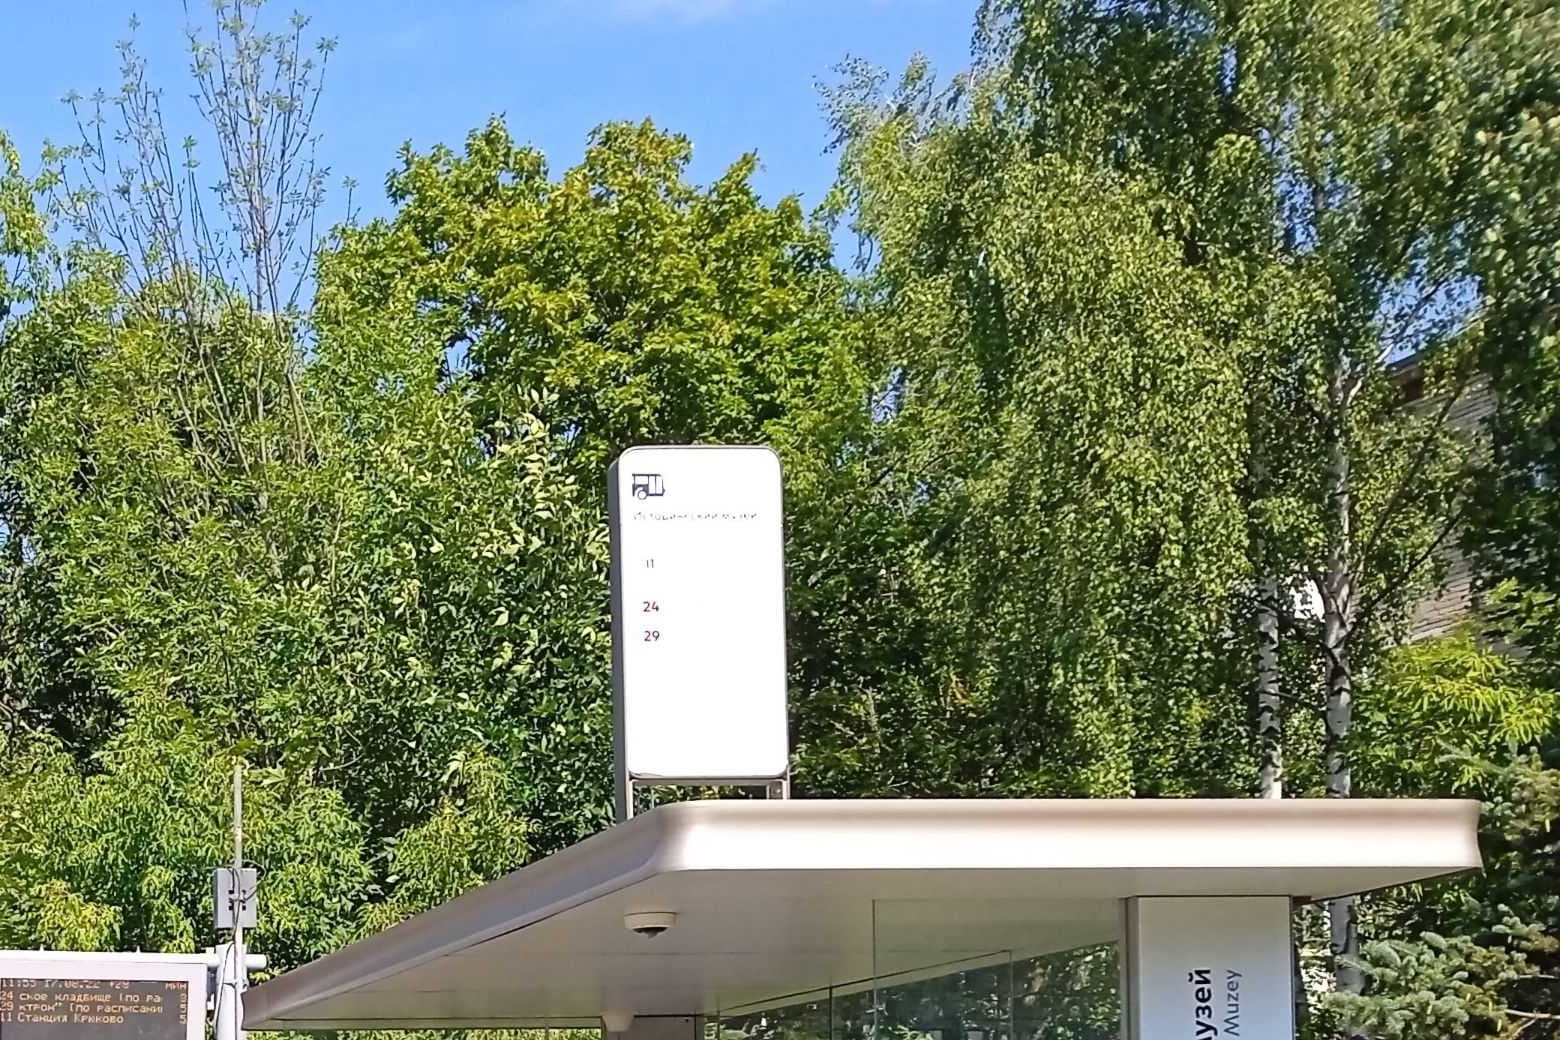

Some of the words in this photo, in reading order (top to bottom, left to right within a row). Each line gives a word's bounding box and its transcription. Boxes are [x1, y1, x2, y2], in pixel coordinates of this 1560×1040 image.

[643, 600, 660, 613] 24
[643, 629, 660, 642] 29
[0, 991, 14, 1001] 24
[54, 993, 112, 1003] кладбище
[1224, 969, 1242, 1036] Muzey
[0, 1001, 14, 1011] 29
[96, 1005, 163, 1014] расписани
[17, 1012, 68, 1023] Станция
[73, 1013, 124, 1024] Крюково
